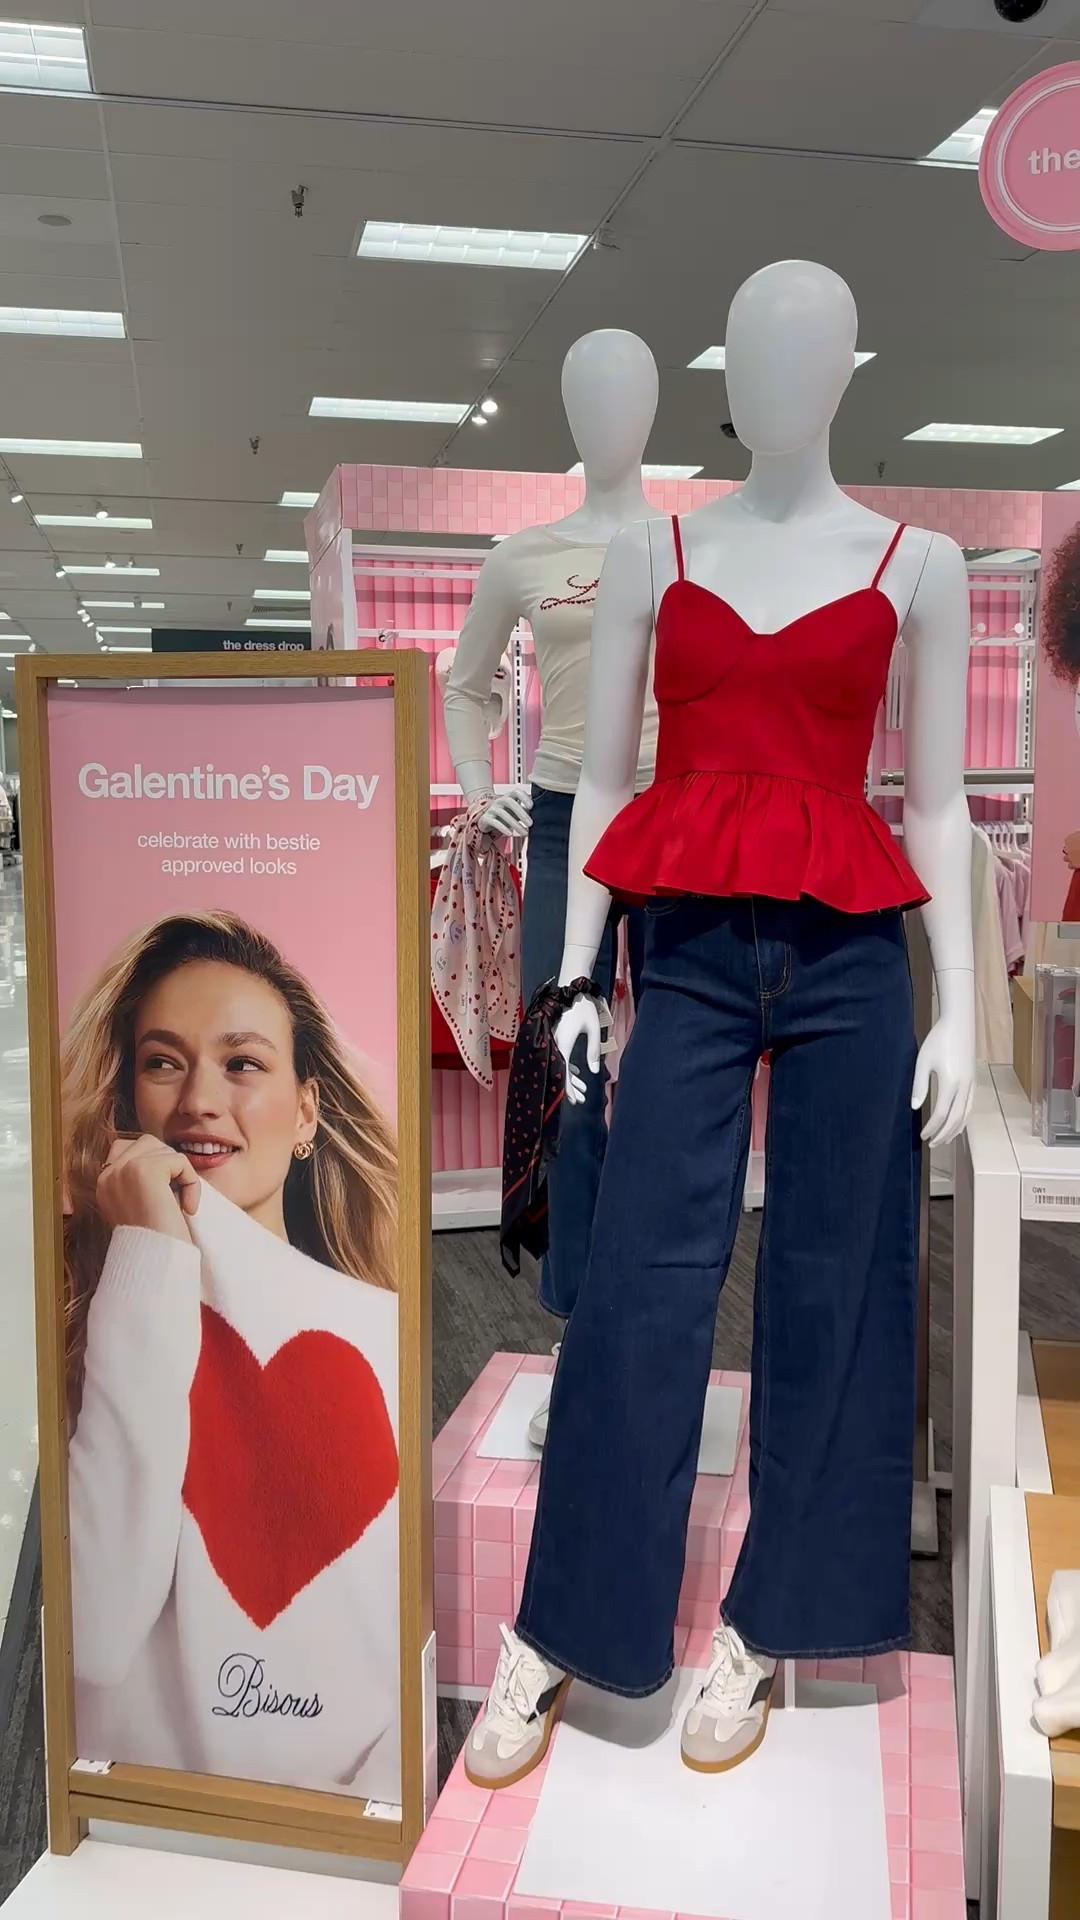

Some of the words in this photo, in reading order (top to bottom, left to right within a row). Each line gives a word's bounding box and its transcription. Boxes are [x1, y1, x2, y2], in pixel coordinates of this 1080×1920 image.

[1028, 148, 1080, 174] the
[223, 640, 242, 650] the
[244, 640, 276, 651] dress
[278, 641, 304, 651] drop
[78, 763, 290, 801] Galentine’s
[303, 765, 380, 809] Day
[137, 832, 219, 849] celebrate
[224, 833, 260, 849] with
[266, 833, 320, 850] bestie
[161, 857, 244, 876] approved
[250, 857, 297, 875] looks
[212, 1652, 324, 1718] Bisous
